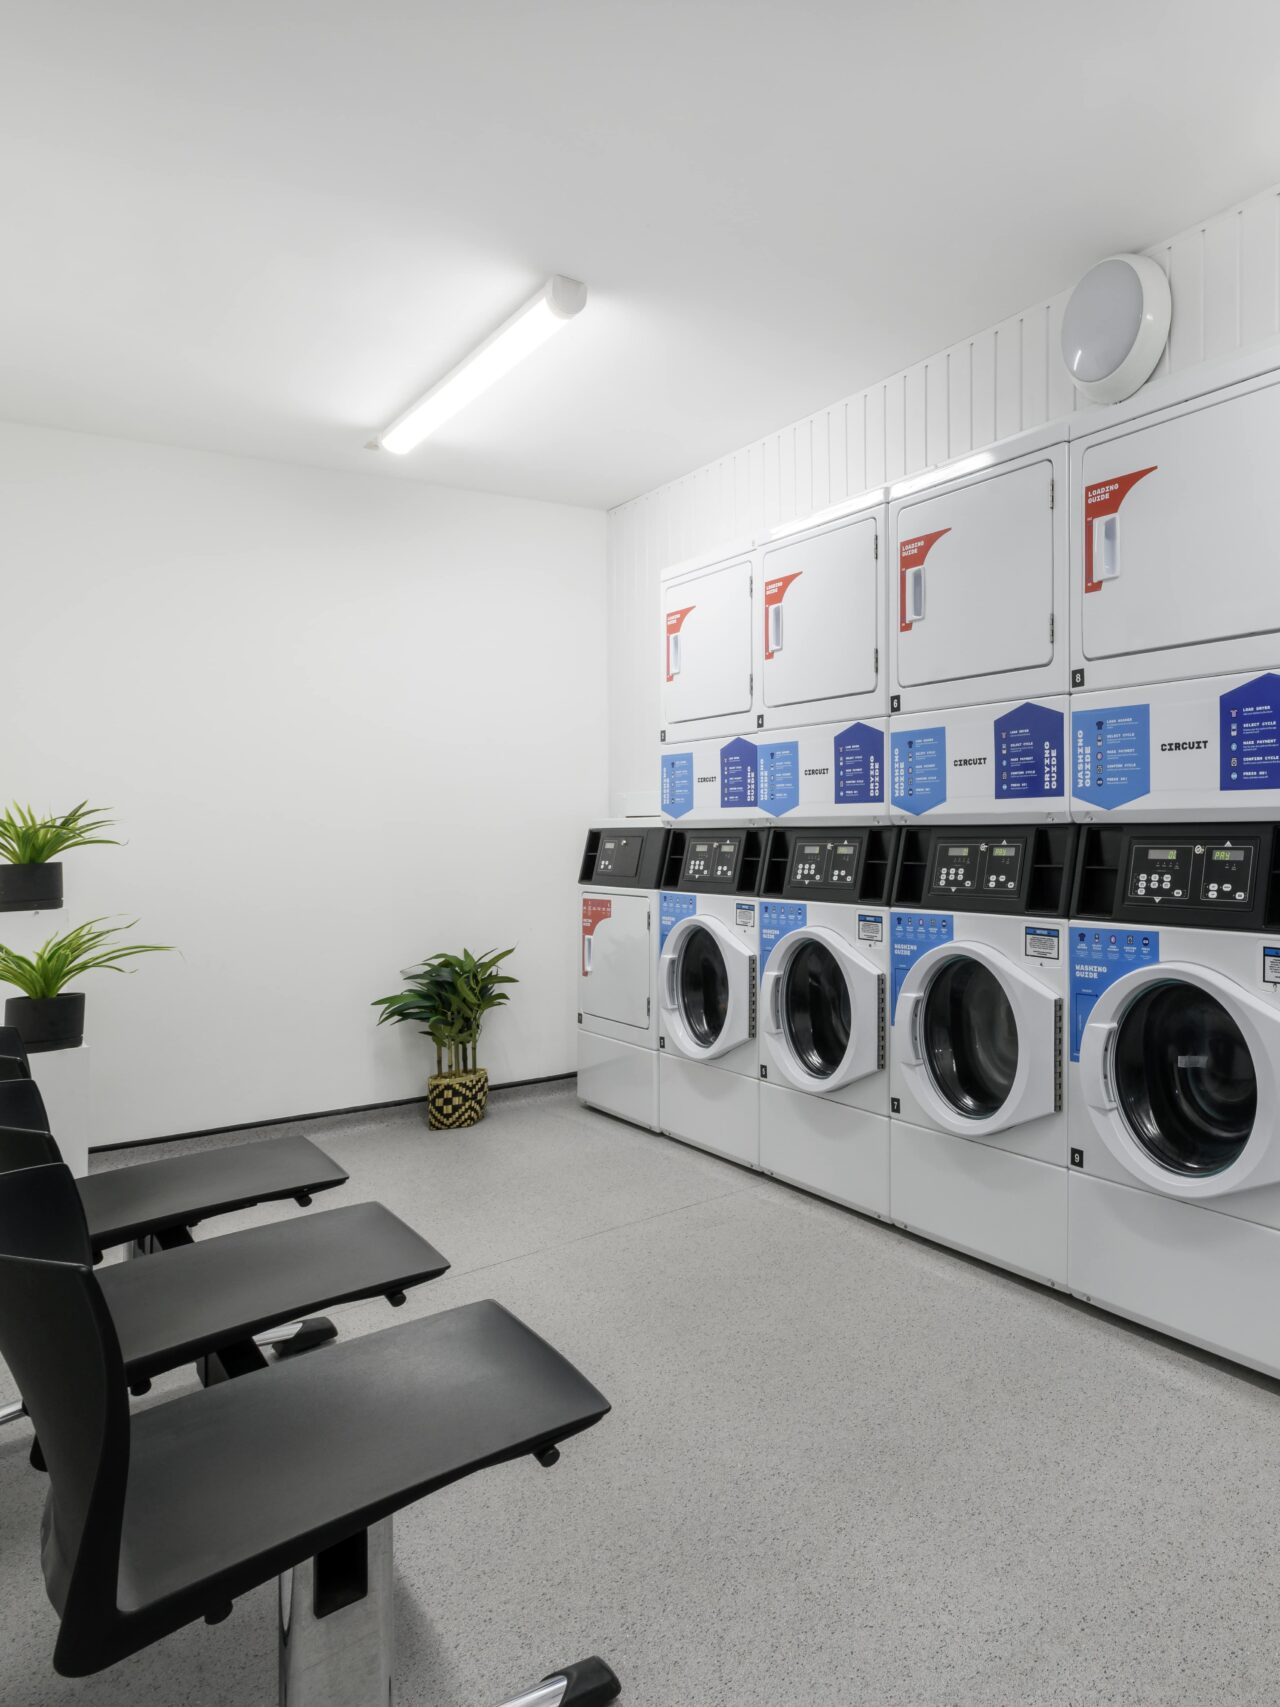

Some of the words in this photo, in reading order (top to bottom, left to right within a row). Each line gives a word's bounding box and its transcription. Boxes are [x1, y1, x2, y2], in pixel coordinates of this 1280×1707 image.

[1088, 483, 1119, 498] LOADING
[1088, 493, 1110, 504] GUIDE
[1075, 674, 1081, 683] 8
[1160, 741, 1208, 752] CIRCUIT
[953, 758, 987, 767] CIRCUIT
[1215, 852, 1230, 860] PAY
[1075, 964, 1107, 973] WASHING
[1075, 971, 1098, 979] GUIDE
[1075, 1154, 1079, 1162] 9
